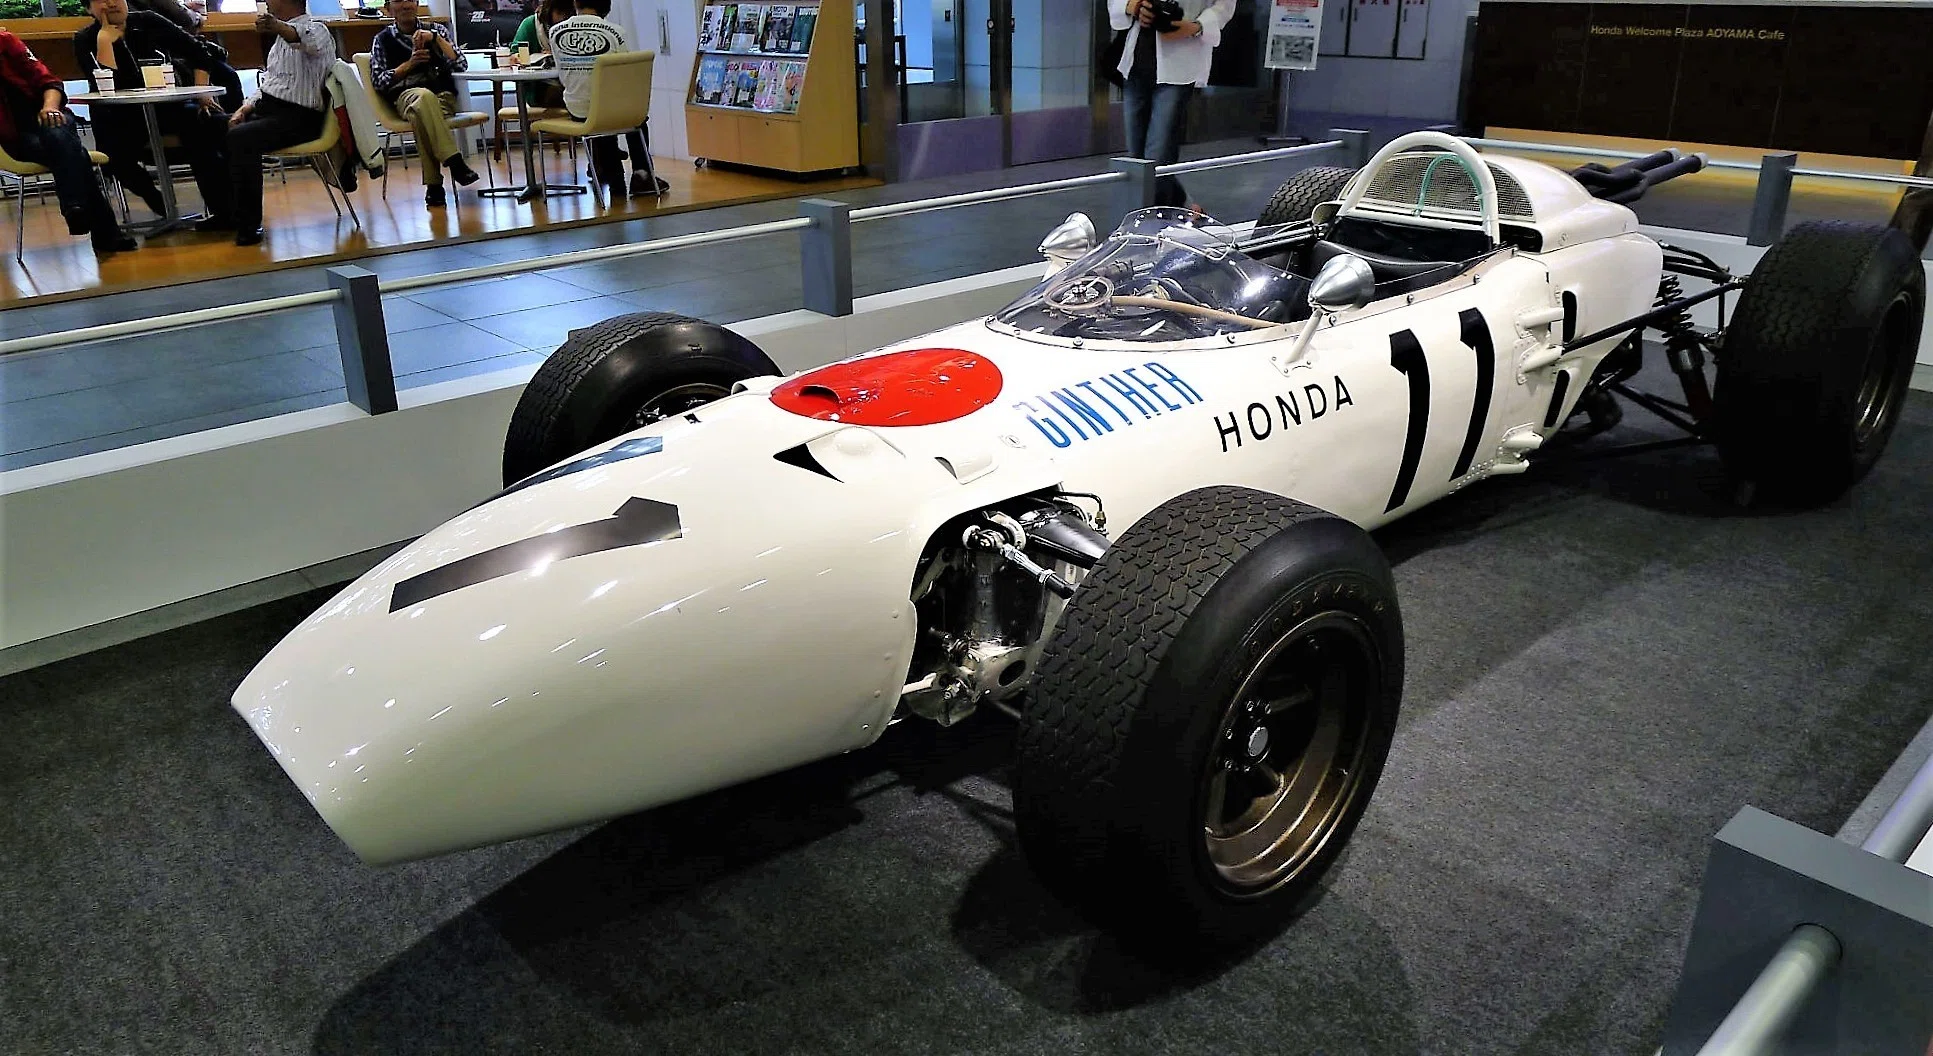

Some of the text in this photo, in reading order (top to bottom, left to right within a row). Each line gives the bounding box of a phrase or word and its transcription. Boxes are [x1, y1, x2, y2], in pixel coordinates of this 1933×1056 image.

[571, 22, 625, 46] International
[1591, 25, 1785, 40] Honda Welcome Plaza AOYAMA Cafe
[1012, 362, 1204, 448] GINTHER
[1213, 375, 1354, 452] HONDA
[1384, 306, 1496, 515] 11
